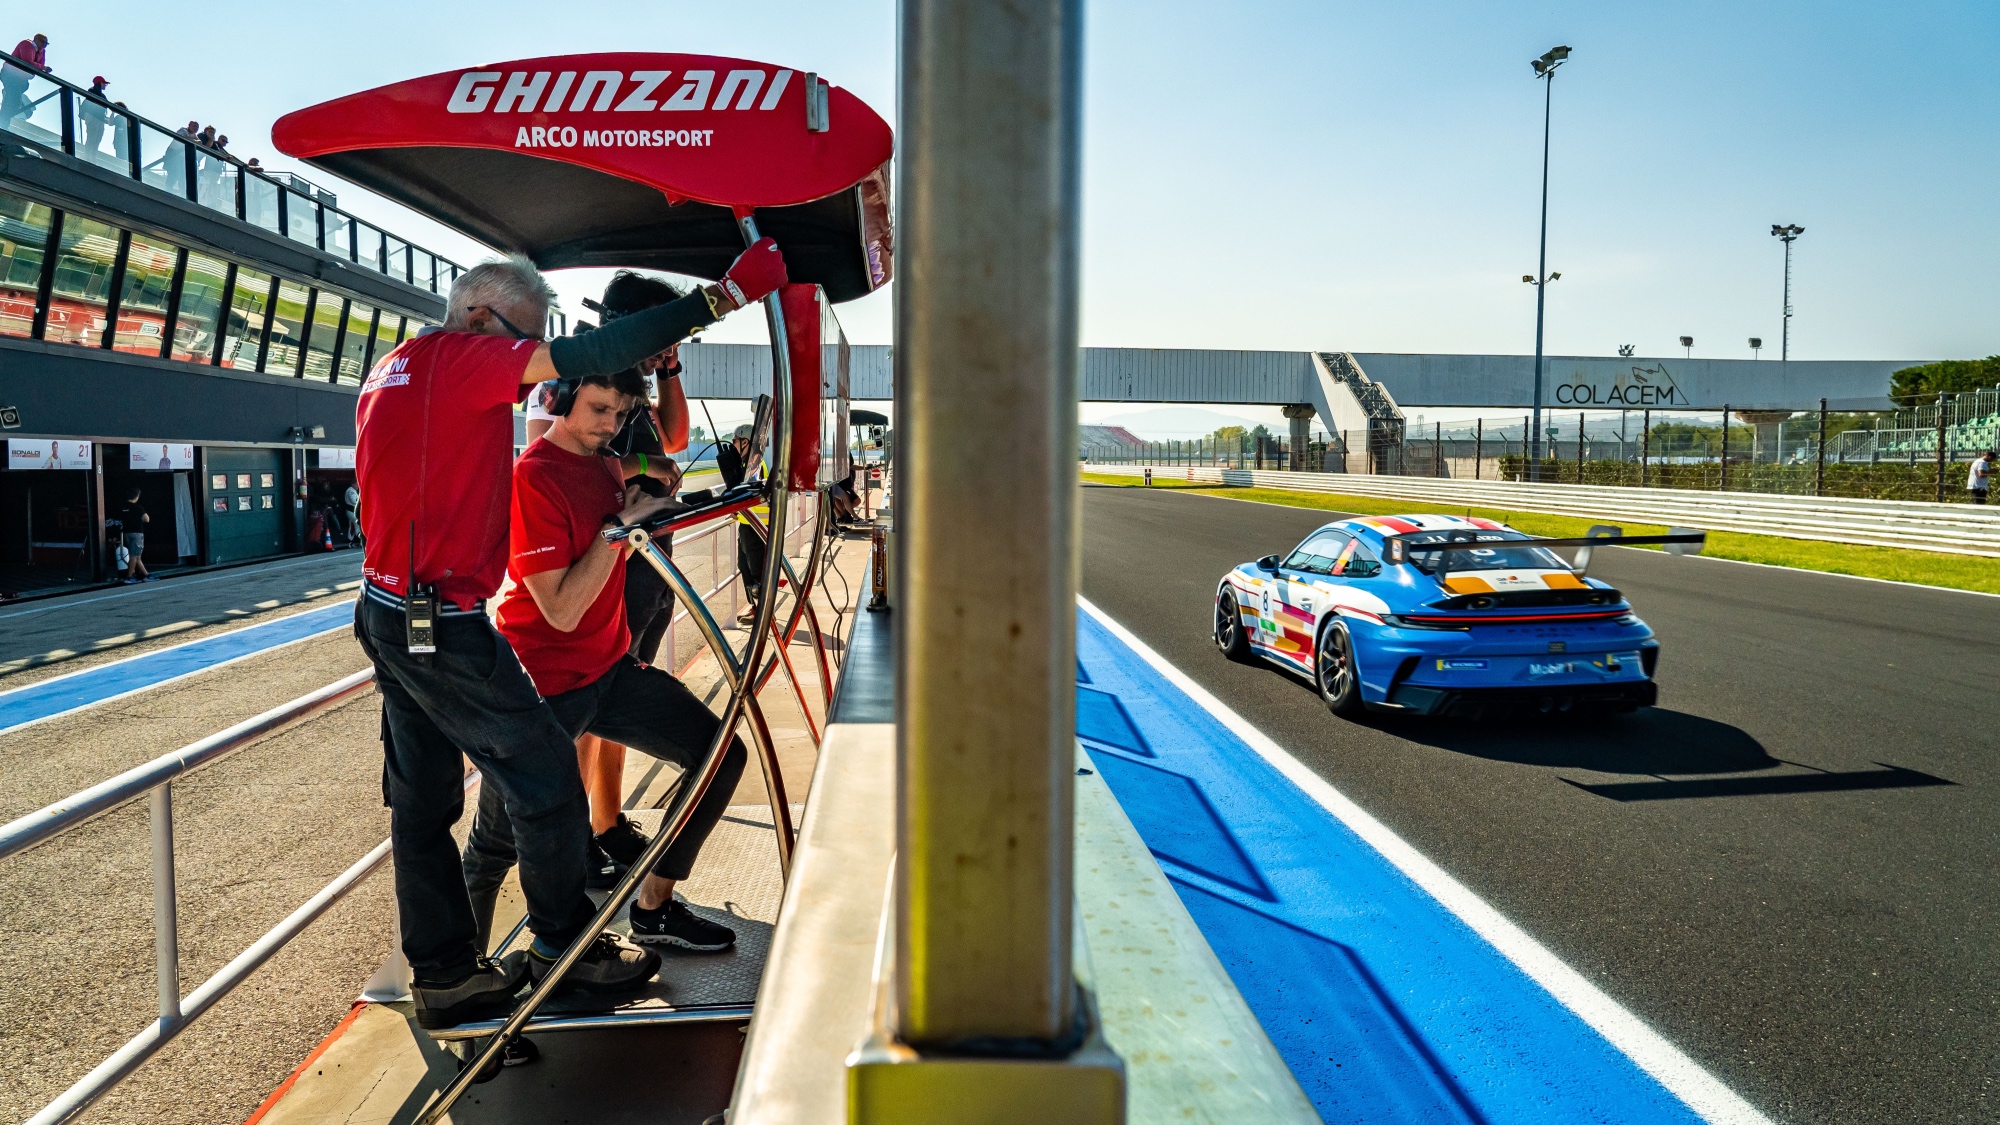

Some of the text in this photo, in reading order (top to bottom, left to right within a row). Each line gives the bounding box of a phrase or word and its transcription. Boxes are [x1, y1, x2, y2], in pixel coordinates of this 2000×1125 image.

[446, 69, 793, 114] GHINZANI
[515, 126, 714, 148] ARCO MOTORSPORT
[1556, 384, 1674, 405] COLACEM
[78, 444, 89, 458] 21
[183, 447, 192, 459] 16
[1263, 590, 1268, 612] 8
